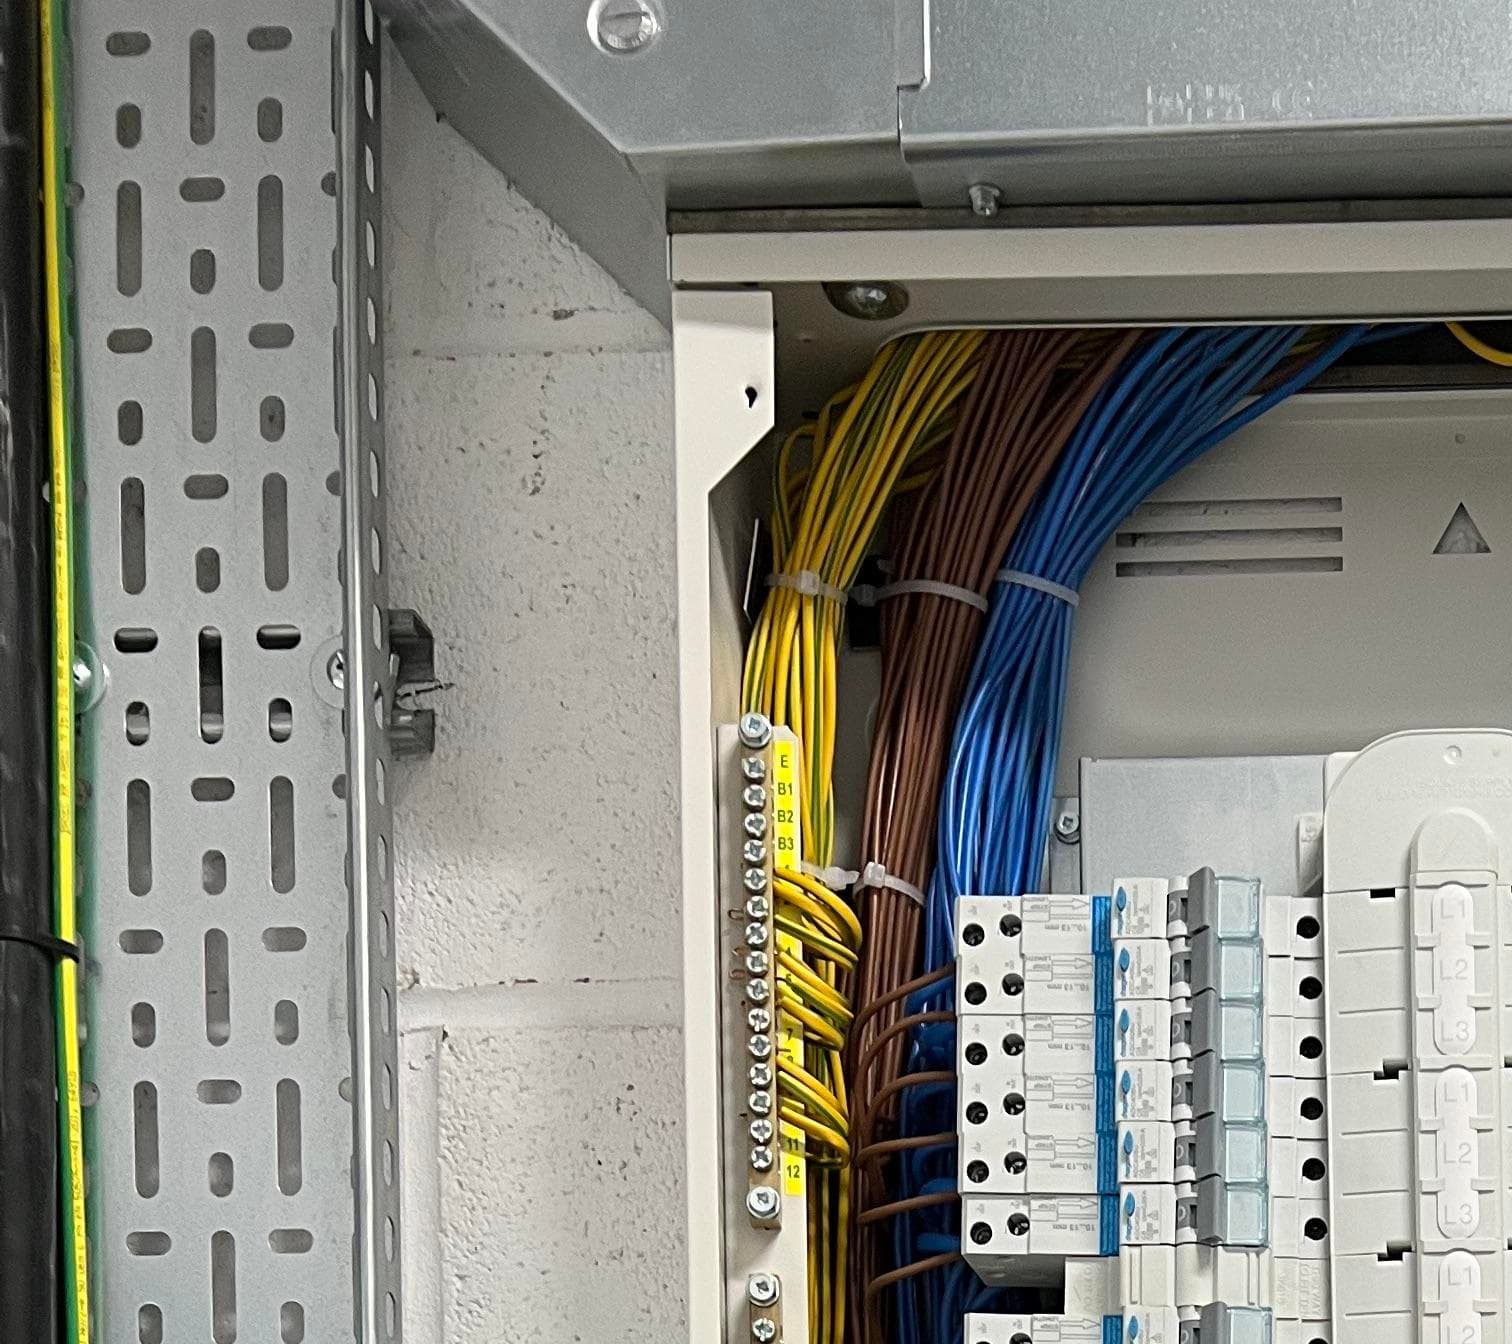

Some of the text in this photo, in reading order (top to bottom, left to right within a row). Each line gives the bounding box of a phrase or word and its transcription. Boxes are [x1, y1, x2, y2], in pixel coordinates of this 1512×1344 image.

[781, 755, 789, 768] E
[778, 783, 792, 795] B1
[778, 810, 794, 823] B2
[778, 837, 794, 850] B3
[1441, 898, 1465, 919] L1
[1440, 959, 1468, 980] L2
[1441, 1021, 1469, 1042] L3
[1444, 1082, 1469, 1102] L1
[787, 1138, 799, 1150] 11
[1444, 1142, 1472, 1163] L2
[787, 1165, 800, 1178] 12
[1444, 1204, 1473, 1225] L3
[1448, 1264, 1472, 1286] L1
